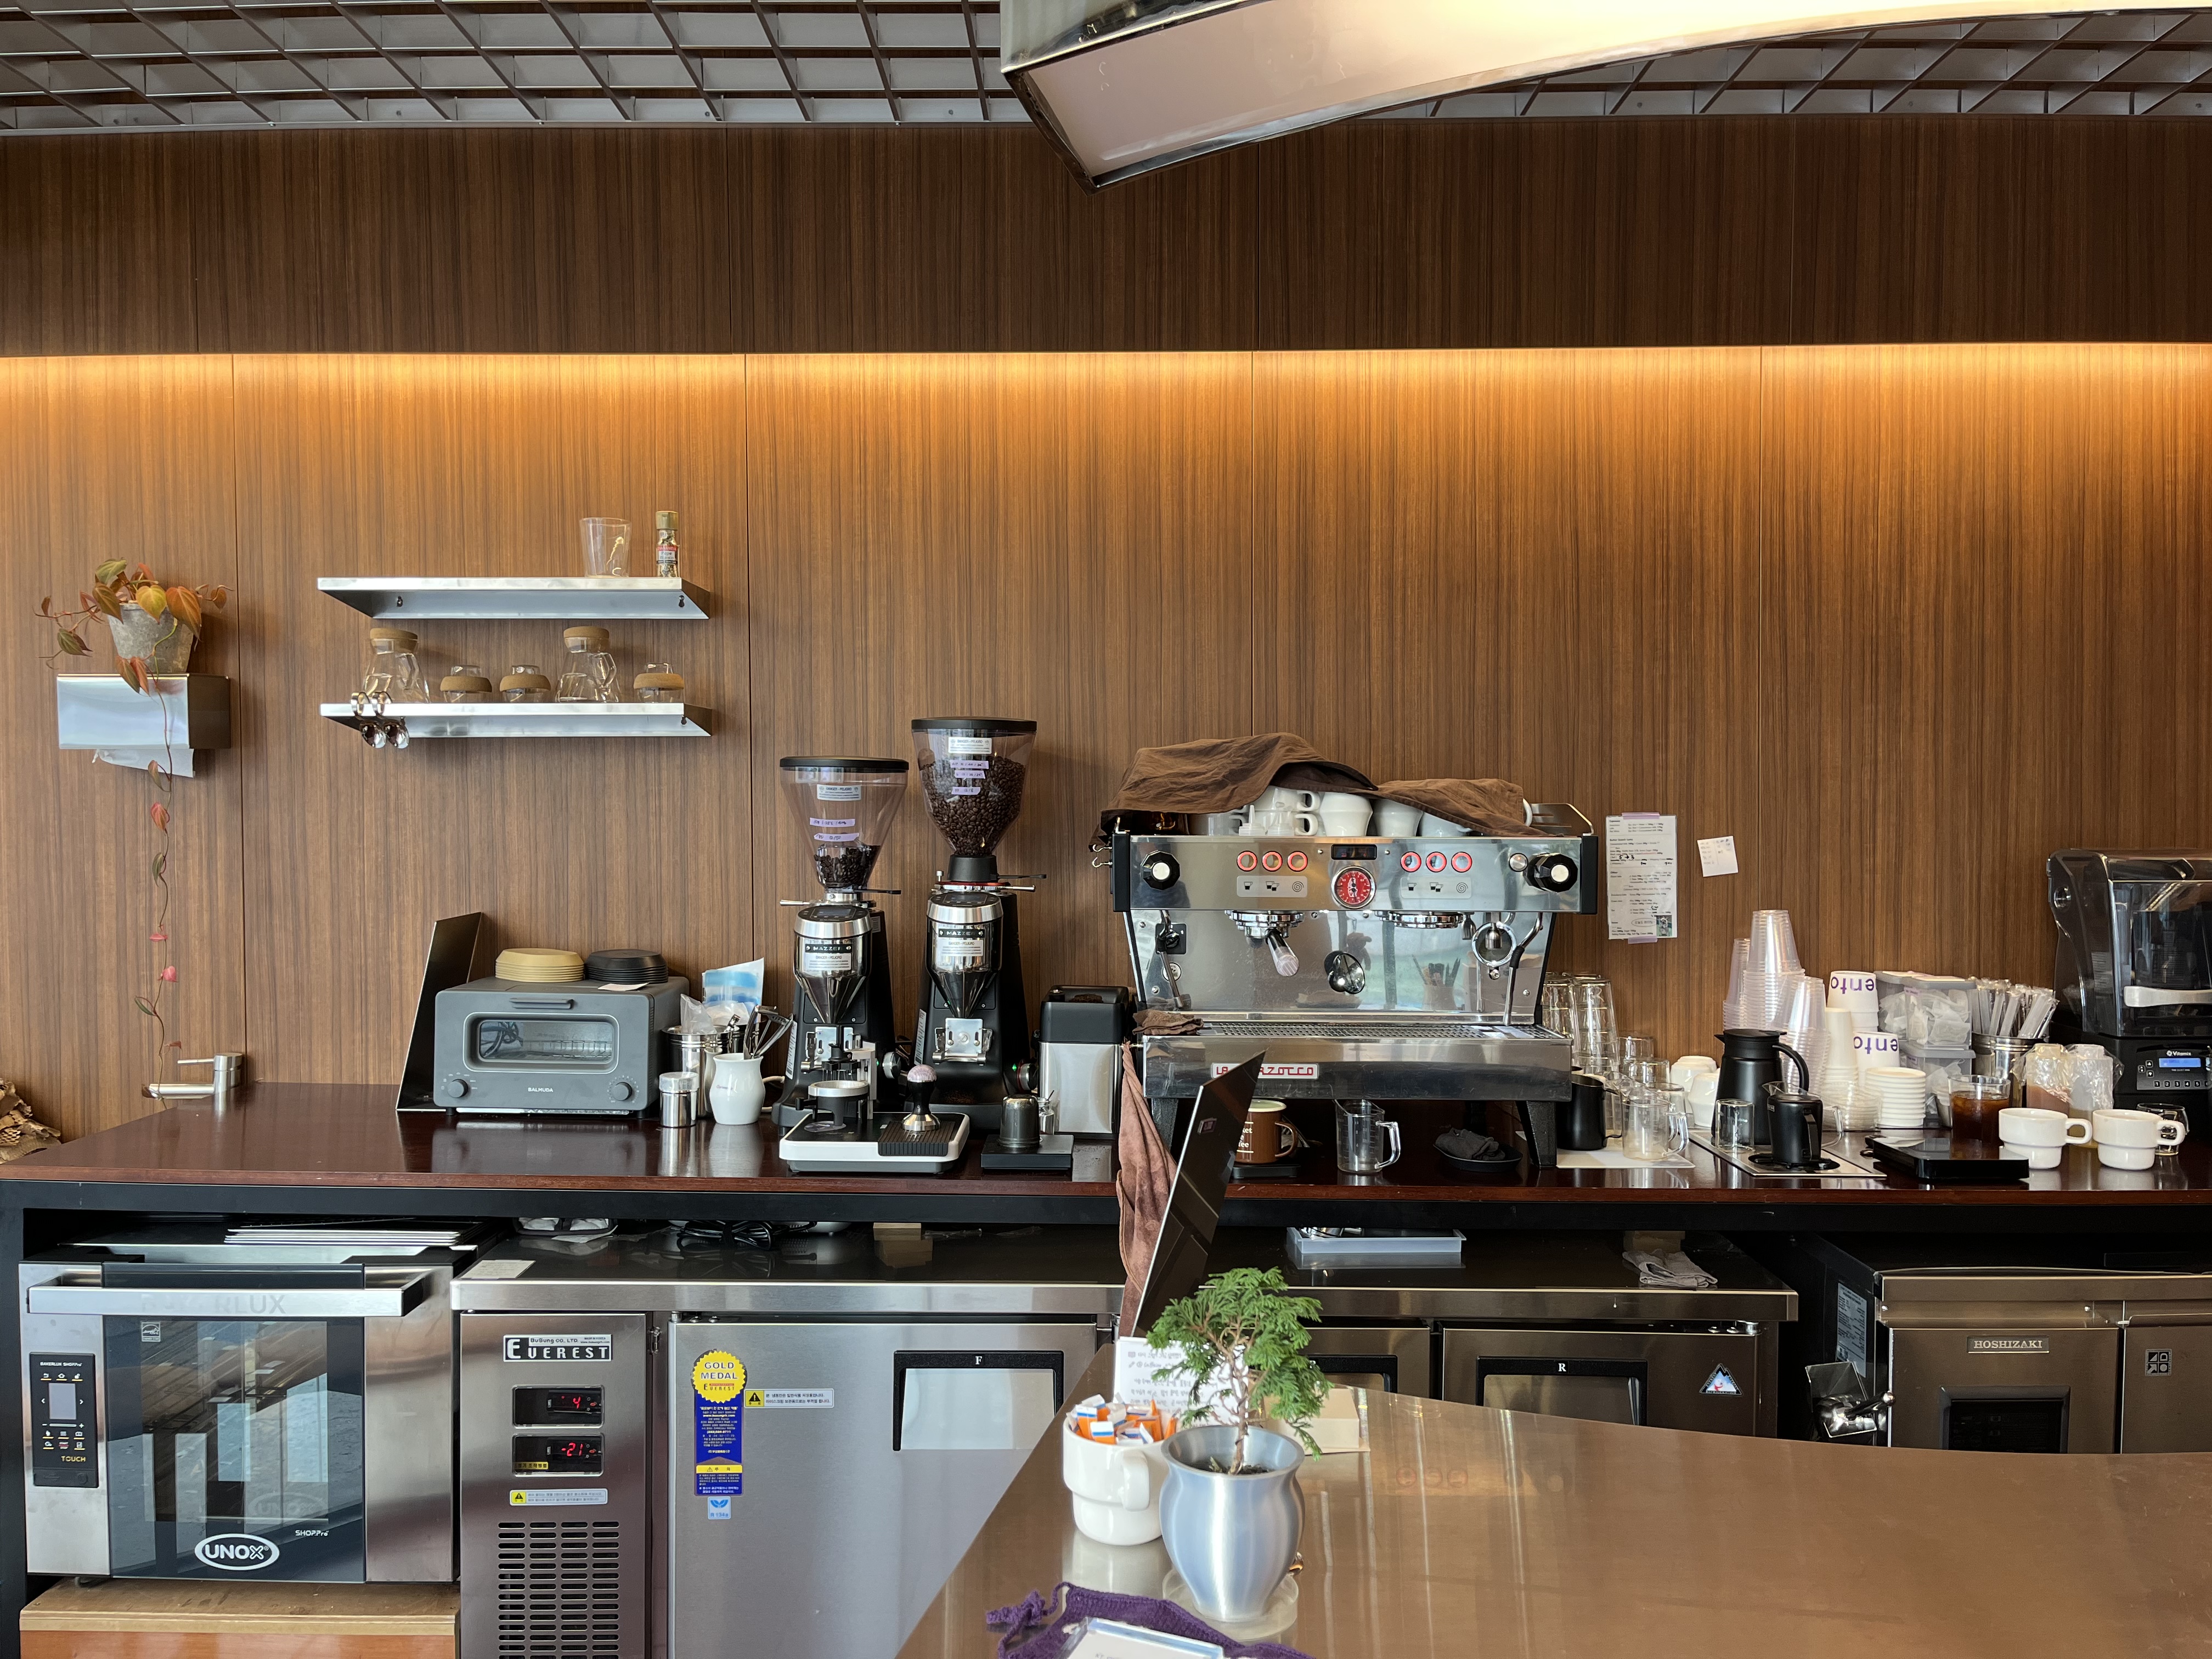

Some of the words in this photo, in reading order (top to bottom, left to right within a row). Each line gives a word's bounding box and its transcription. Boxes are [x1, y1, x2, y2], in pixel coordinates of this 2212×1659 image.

[507, 1339, 608, 1359] EVEREST
[1974, 1340, 2042, 1348] HOSHIZAKI
[975, 1356, 983, 1365] F
[1558, 1363, 1567, 1372] R
[573, 1396, 581, 1409] 4
[561, 1442, 583, 1457] -21
[205, 1544, 264, 1560] UNOX
